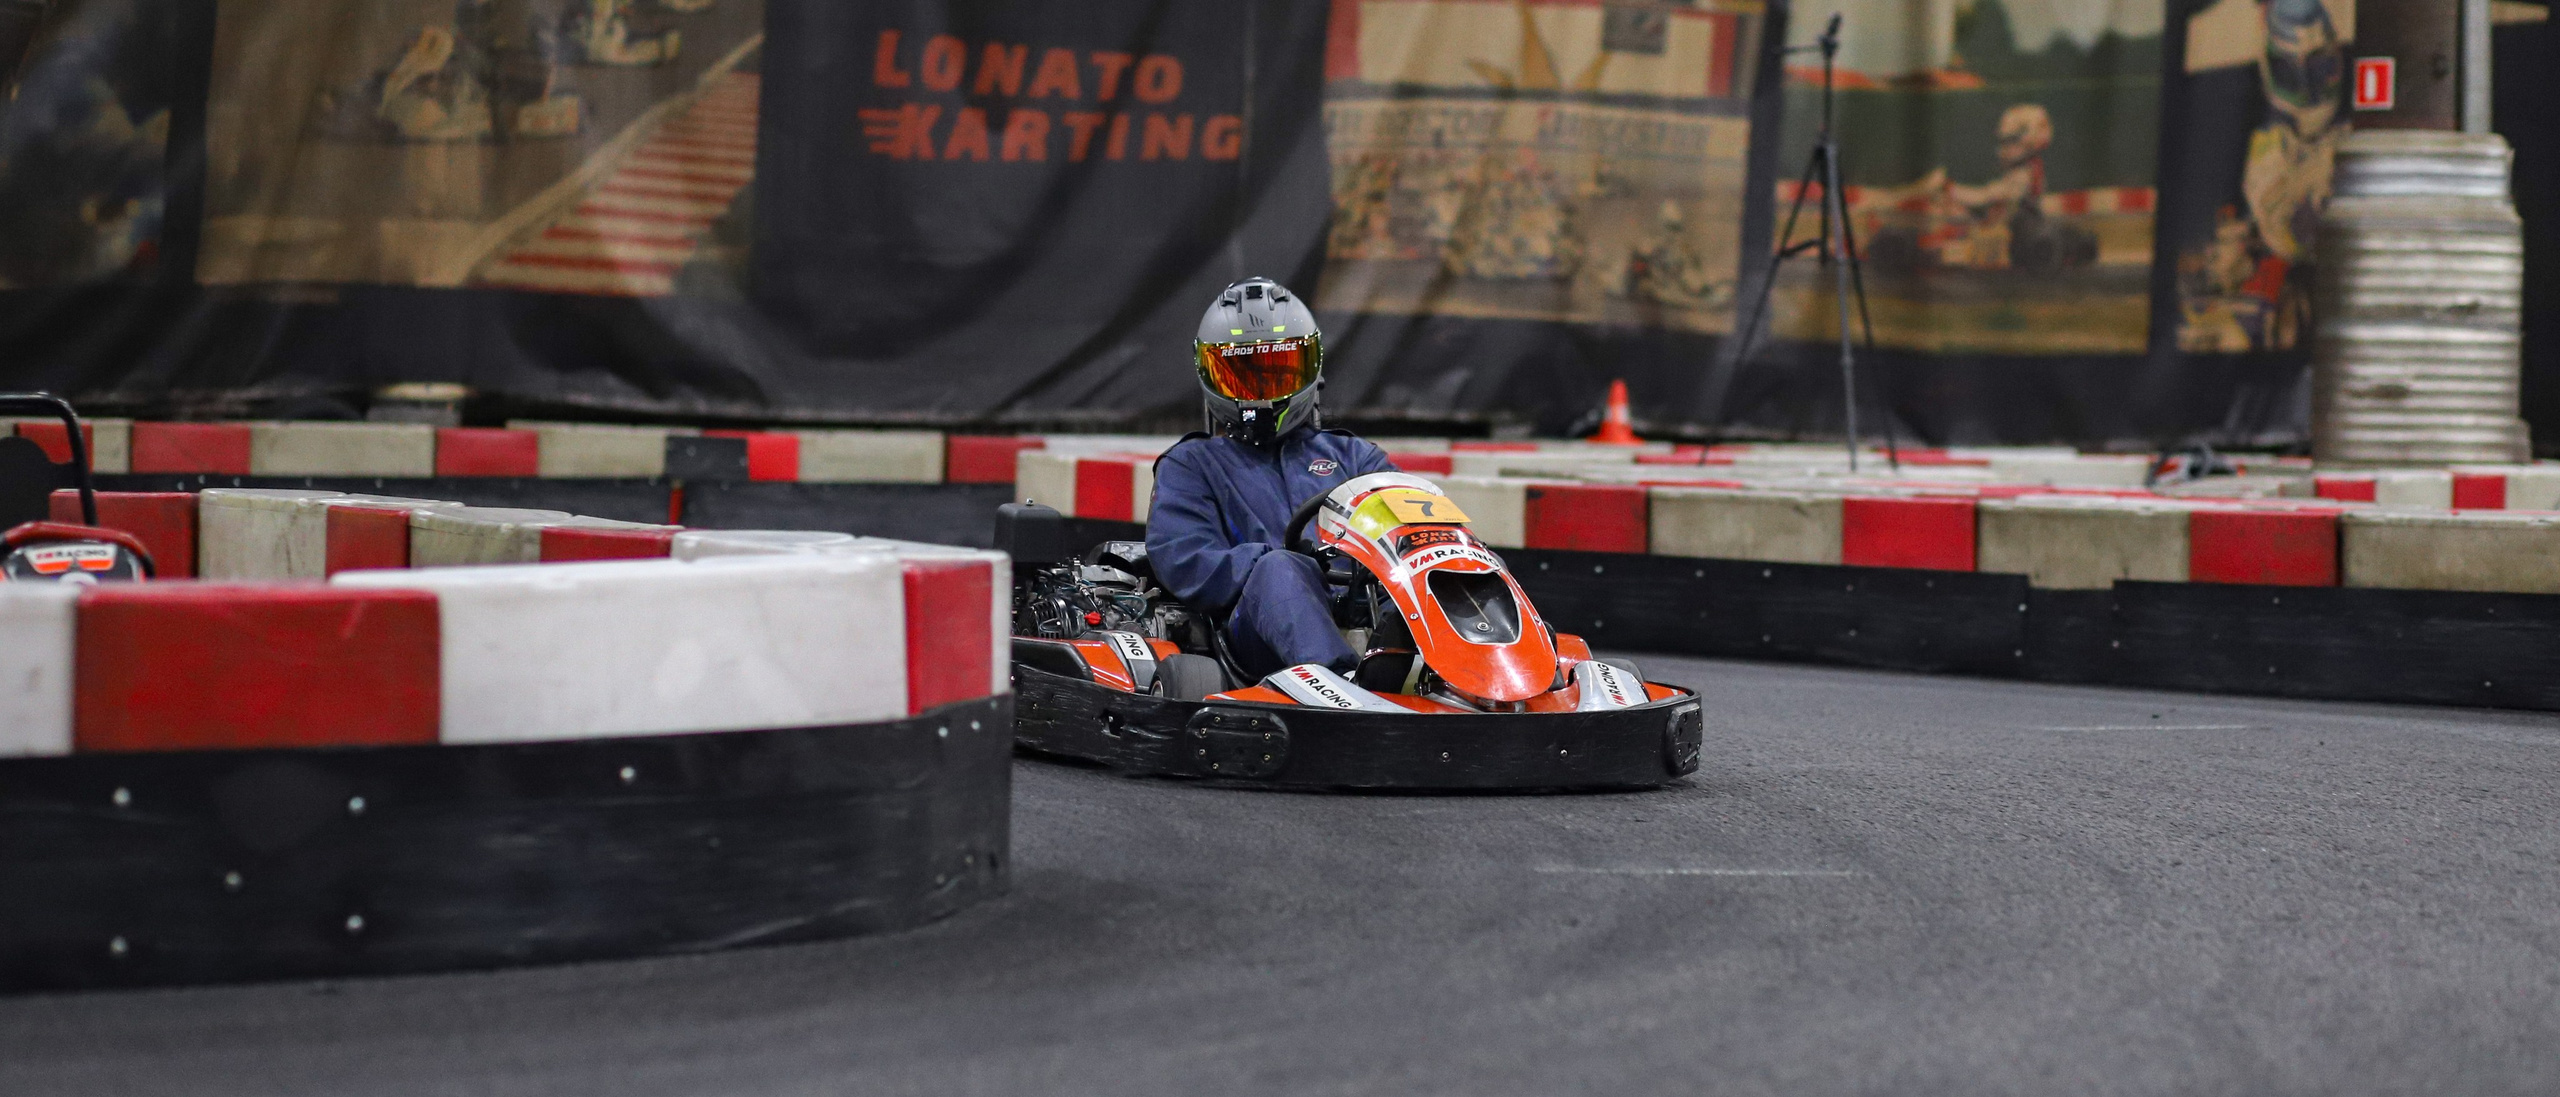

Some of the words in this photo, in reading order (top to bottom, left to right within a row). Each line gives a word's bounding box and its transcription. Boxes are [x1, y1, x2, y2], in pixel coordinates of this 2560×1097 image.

[873, 29, 1185, 104] LONATO
[858, 102, 1243, 163] KARTING
[1221, 346, 1254, 357] READY
[1256, 344, 1270, 354] TO
[1271, 342, 1298, 353] RACE
[1307, 461, 1338, 472] RLG
[1403, 499, 1435, 517] 7
[1410, 531, 1458, 541] LONAT
